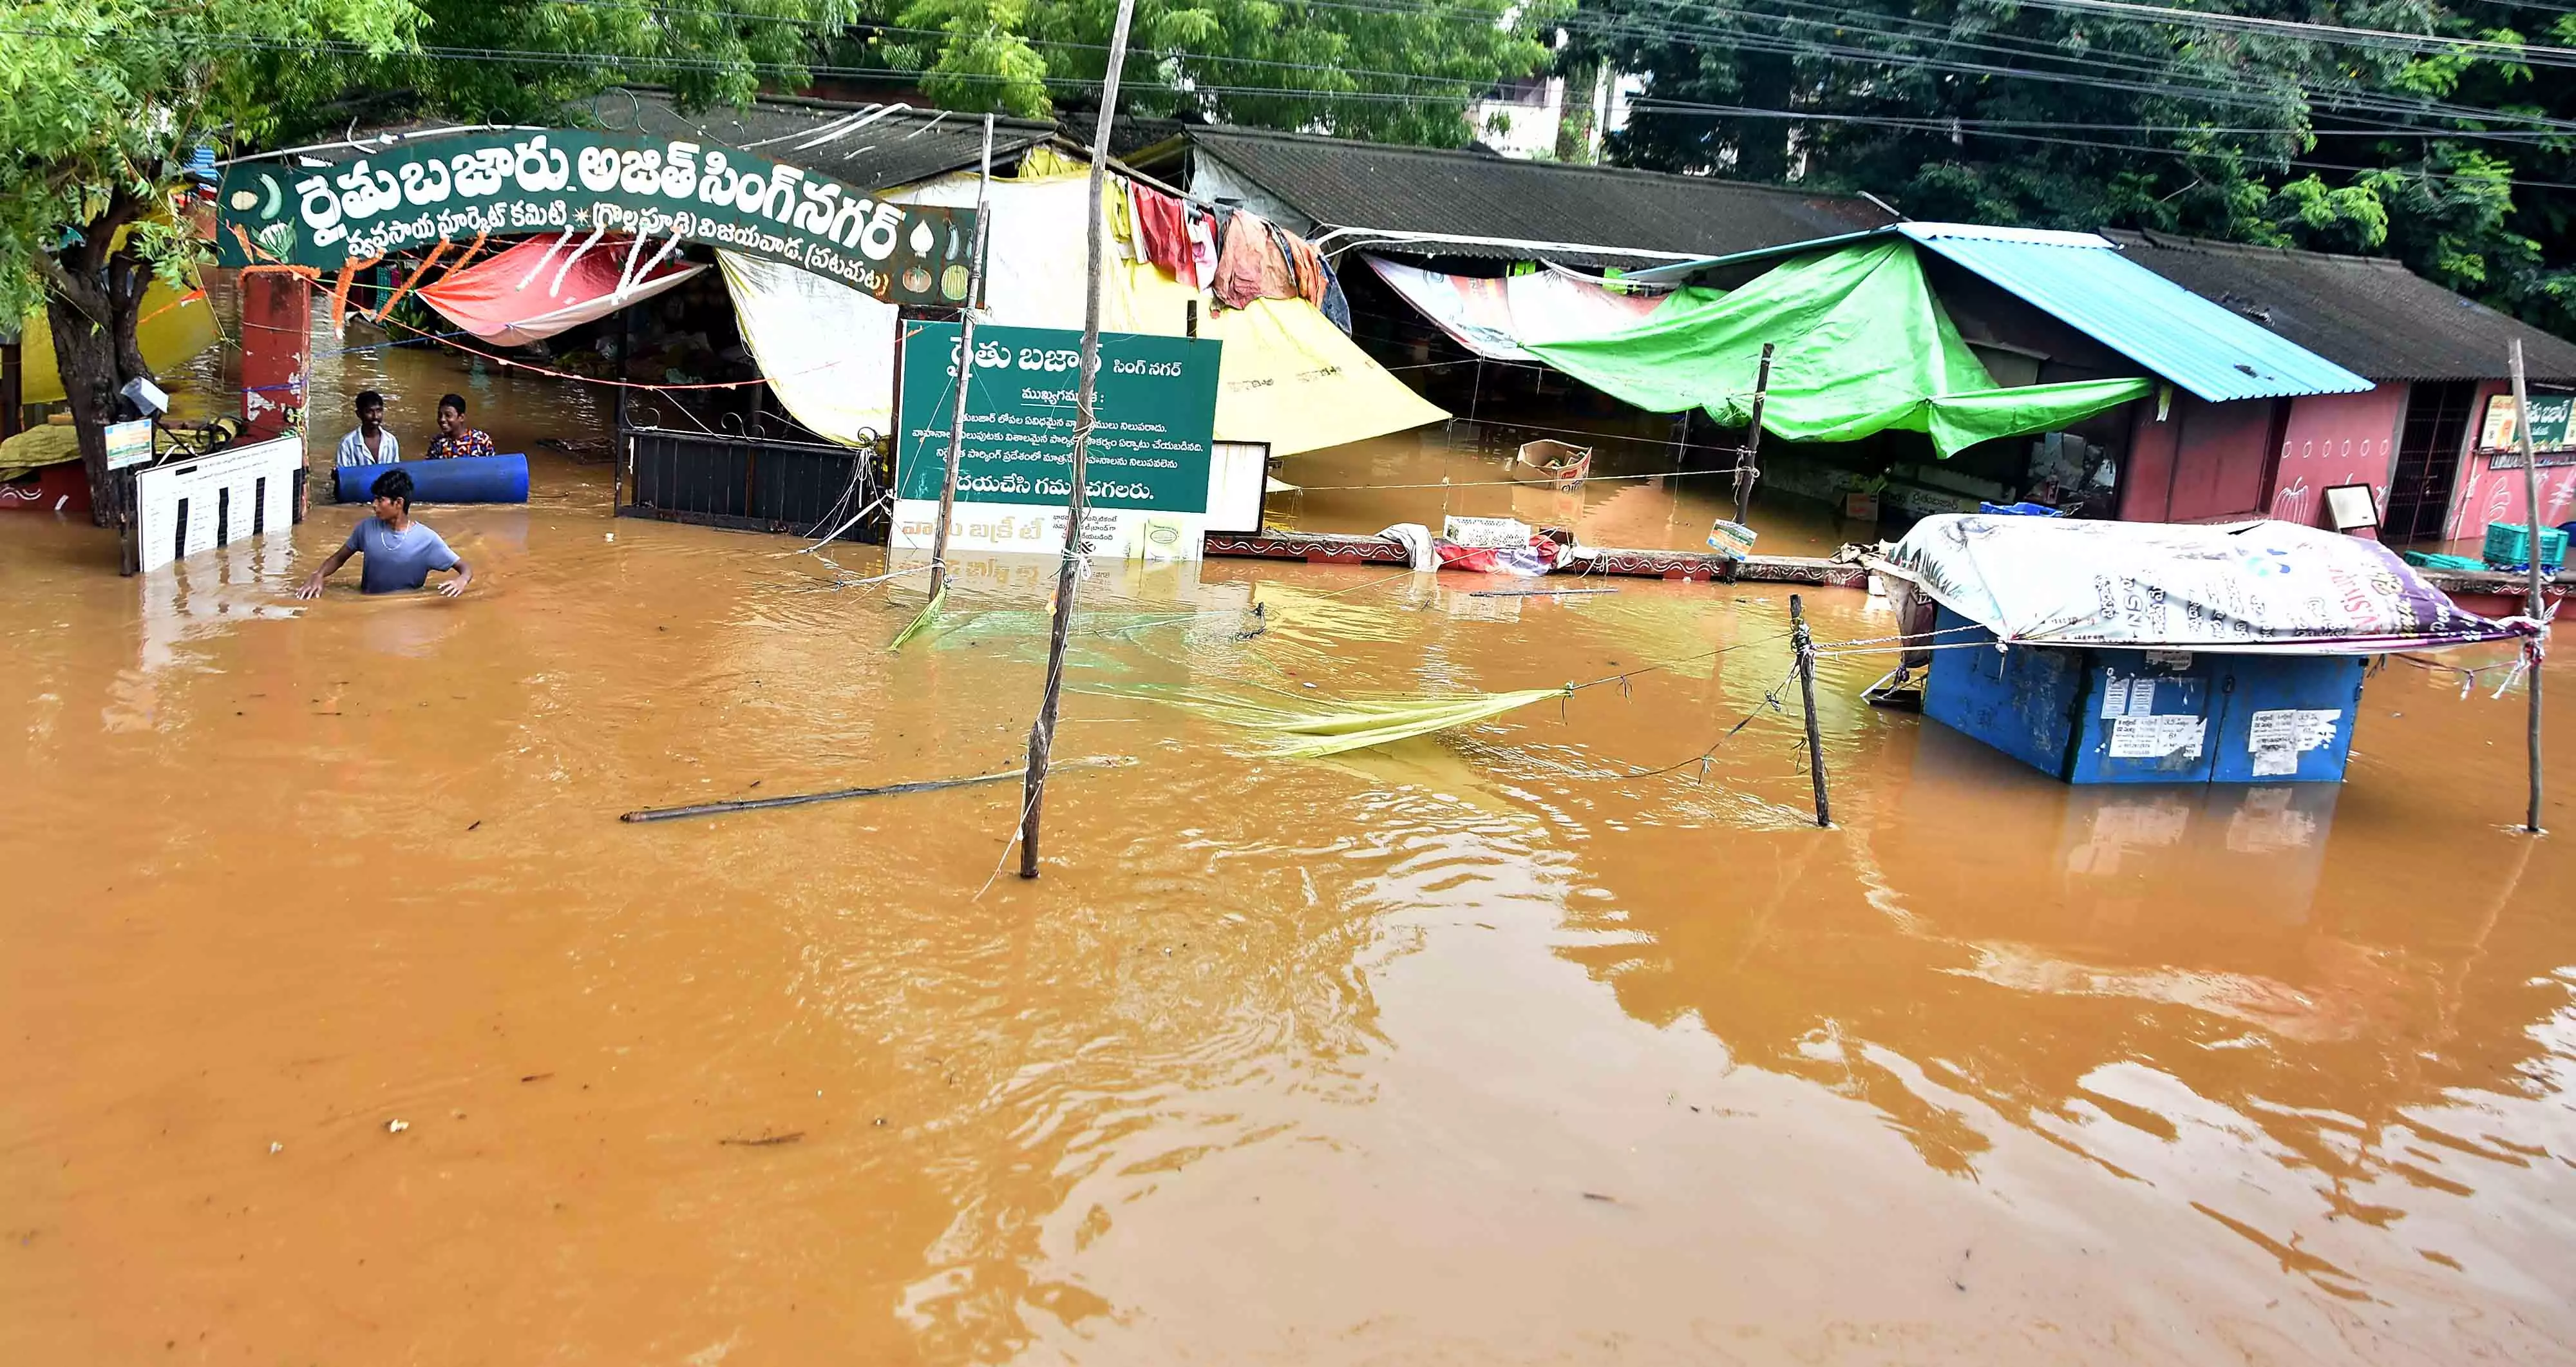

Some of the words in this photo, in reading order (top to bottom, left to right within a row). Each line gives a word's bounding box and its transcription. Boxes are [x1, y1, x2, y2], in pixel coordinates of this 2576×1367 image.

[1113, 359, 1146, 374] సింగ్
[1148, 361, 1182, 377] నగర్
[956, 473, 1030, 494] దయచేసి
